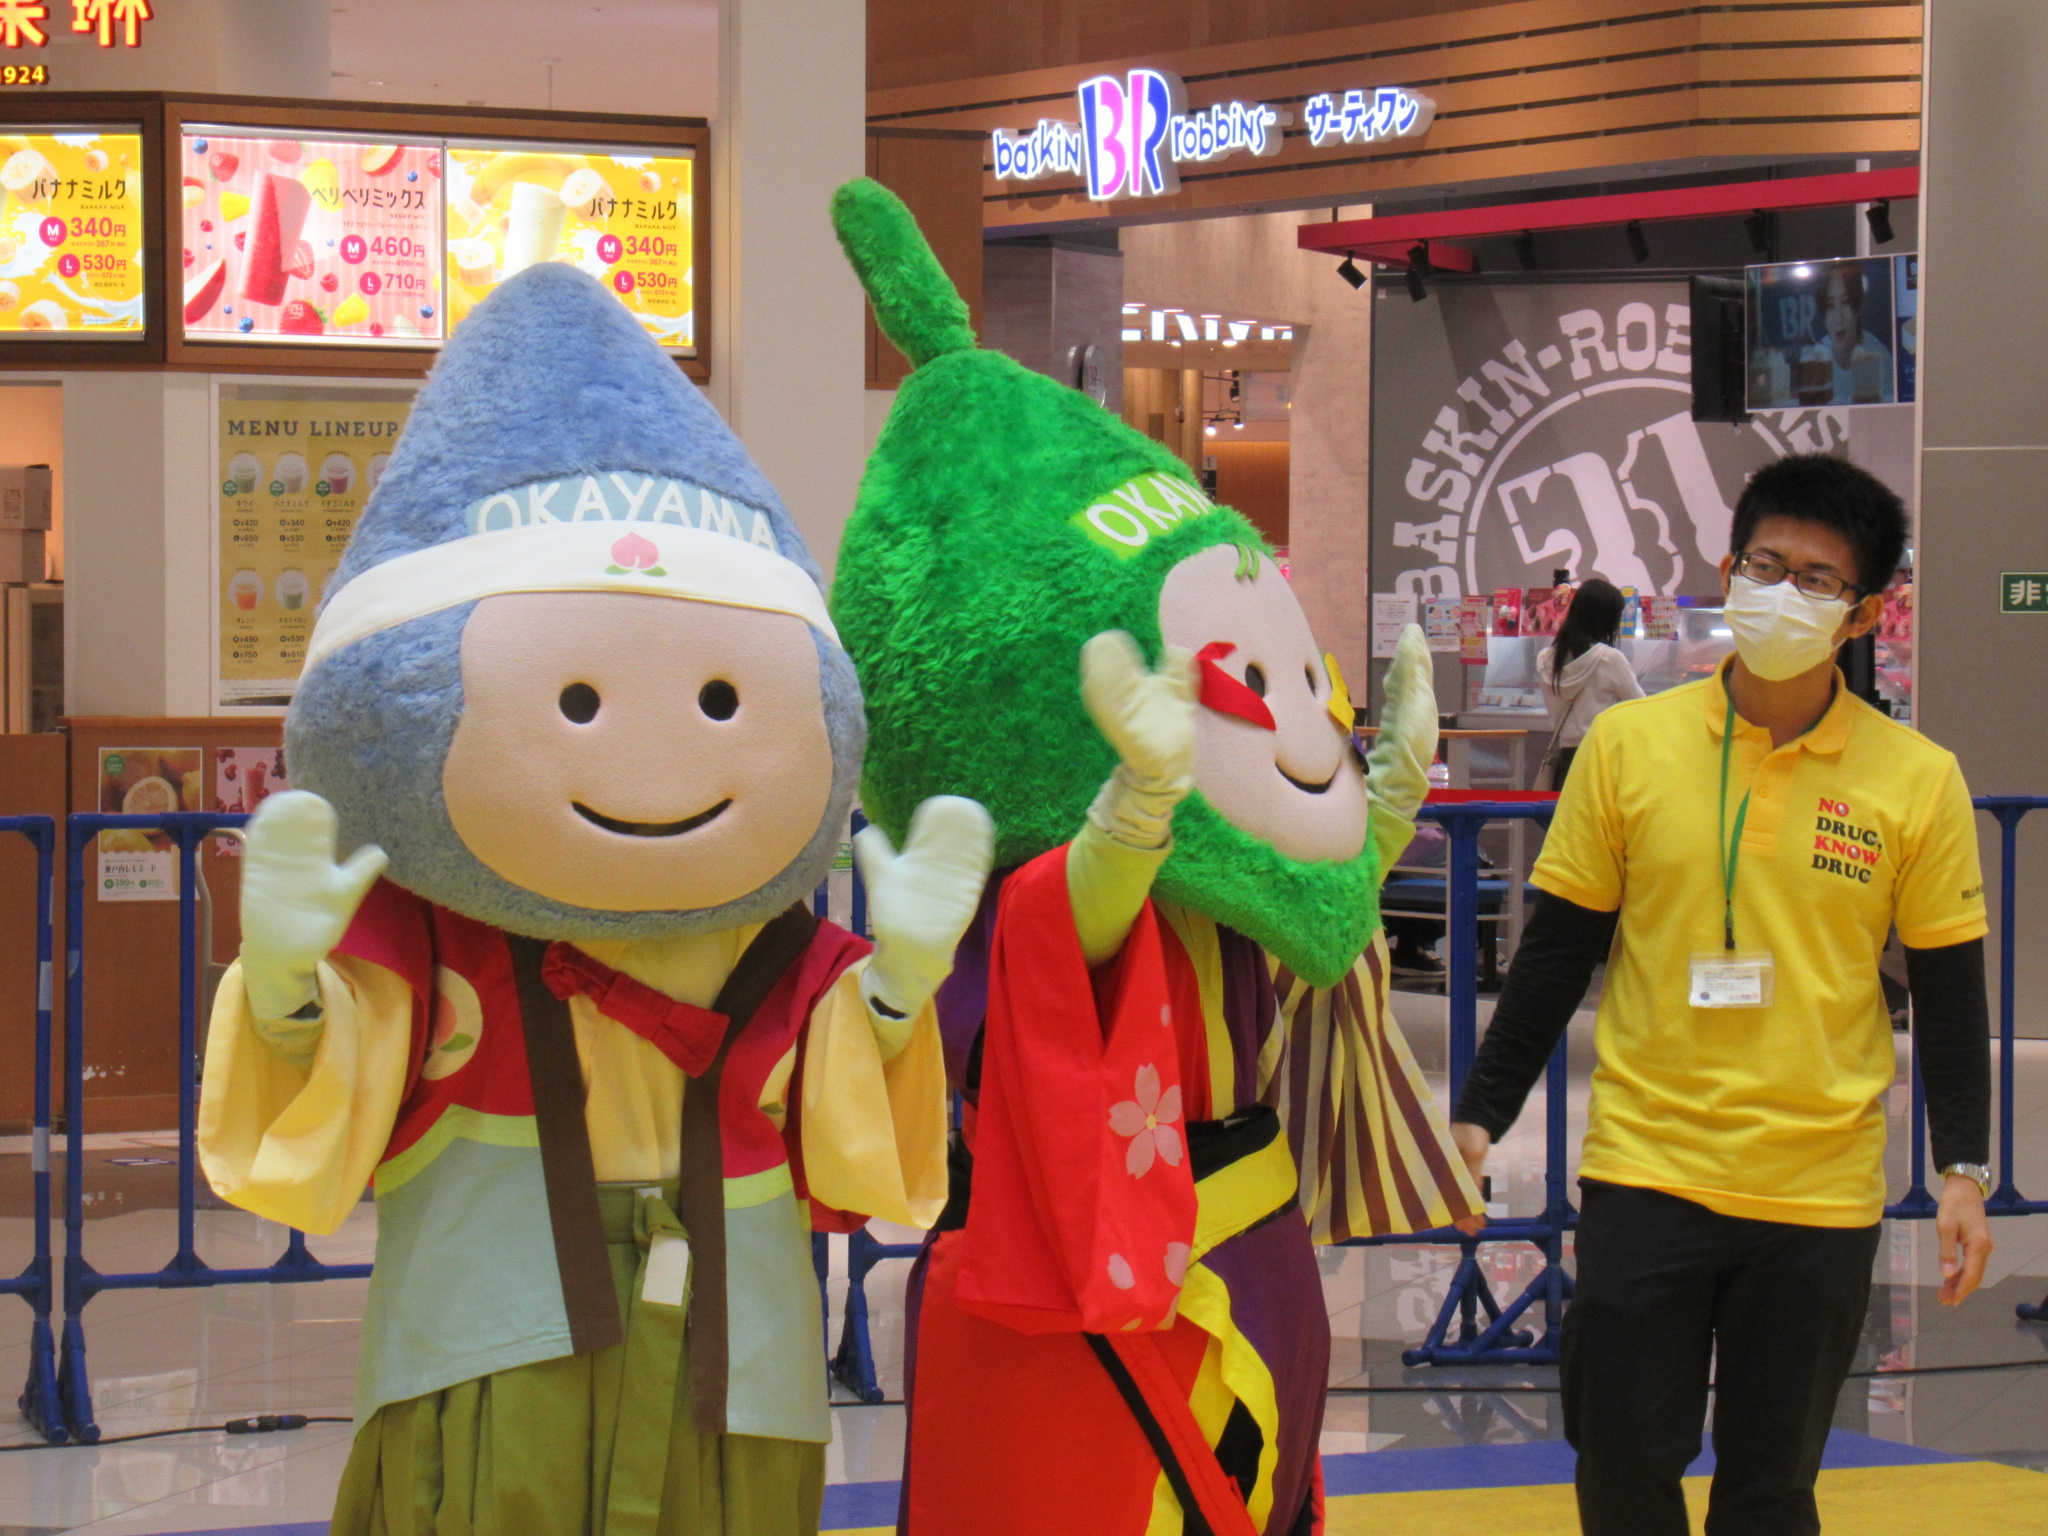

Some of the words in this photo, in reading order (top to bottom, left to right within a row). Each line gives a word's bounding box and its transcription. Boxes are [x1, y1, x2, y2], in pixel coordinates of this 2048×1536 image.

[0, 65, 46, 84] 924
[1305, 87, 1419, 146] サーティワン
[1078, 69, 1171, 200] BR
[32, 178, 126, 200] バナナミルク
[312, 186, 426, 210] ベリベリミックス
[590, 197, 677, 220] バナナミルク
[47, 224, 59, 236] M
[70, 216, 126, 238] 340円
[347, 242, 359, 254] M
[370, 236, 425, 258] 460円
[604, 241, 616, 254] M
[626, 235, 677, 257] 340円
[66, 259, 72, 269] L
[83, 254, 126, 270] 530円
[367, 277, 374, 287] L
[385, 273, 425, 289] 710円
[621, 276, 627, 286] L
[637, 272, 677, 288] 530円
[228, 420, 298, 436] MENU
[310, 421, 399, 437] LINEUP
[477, 474, 778, 552] OKAYAMA
[1086, 474, 1216, 546] OKAY
[2009, 580, 2048, 606] 非
[1817, 797, 1850, 818] NO
[1815, 816, 1883, 850] DRUG,
[1813, 835, 1881, 867] KNOW
[1811, 853, 1872, 884] DRUG
